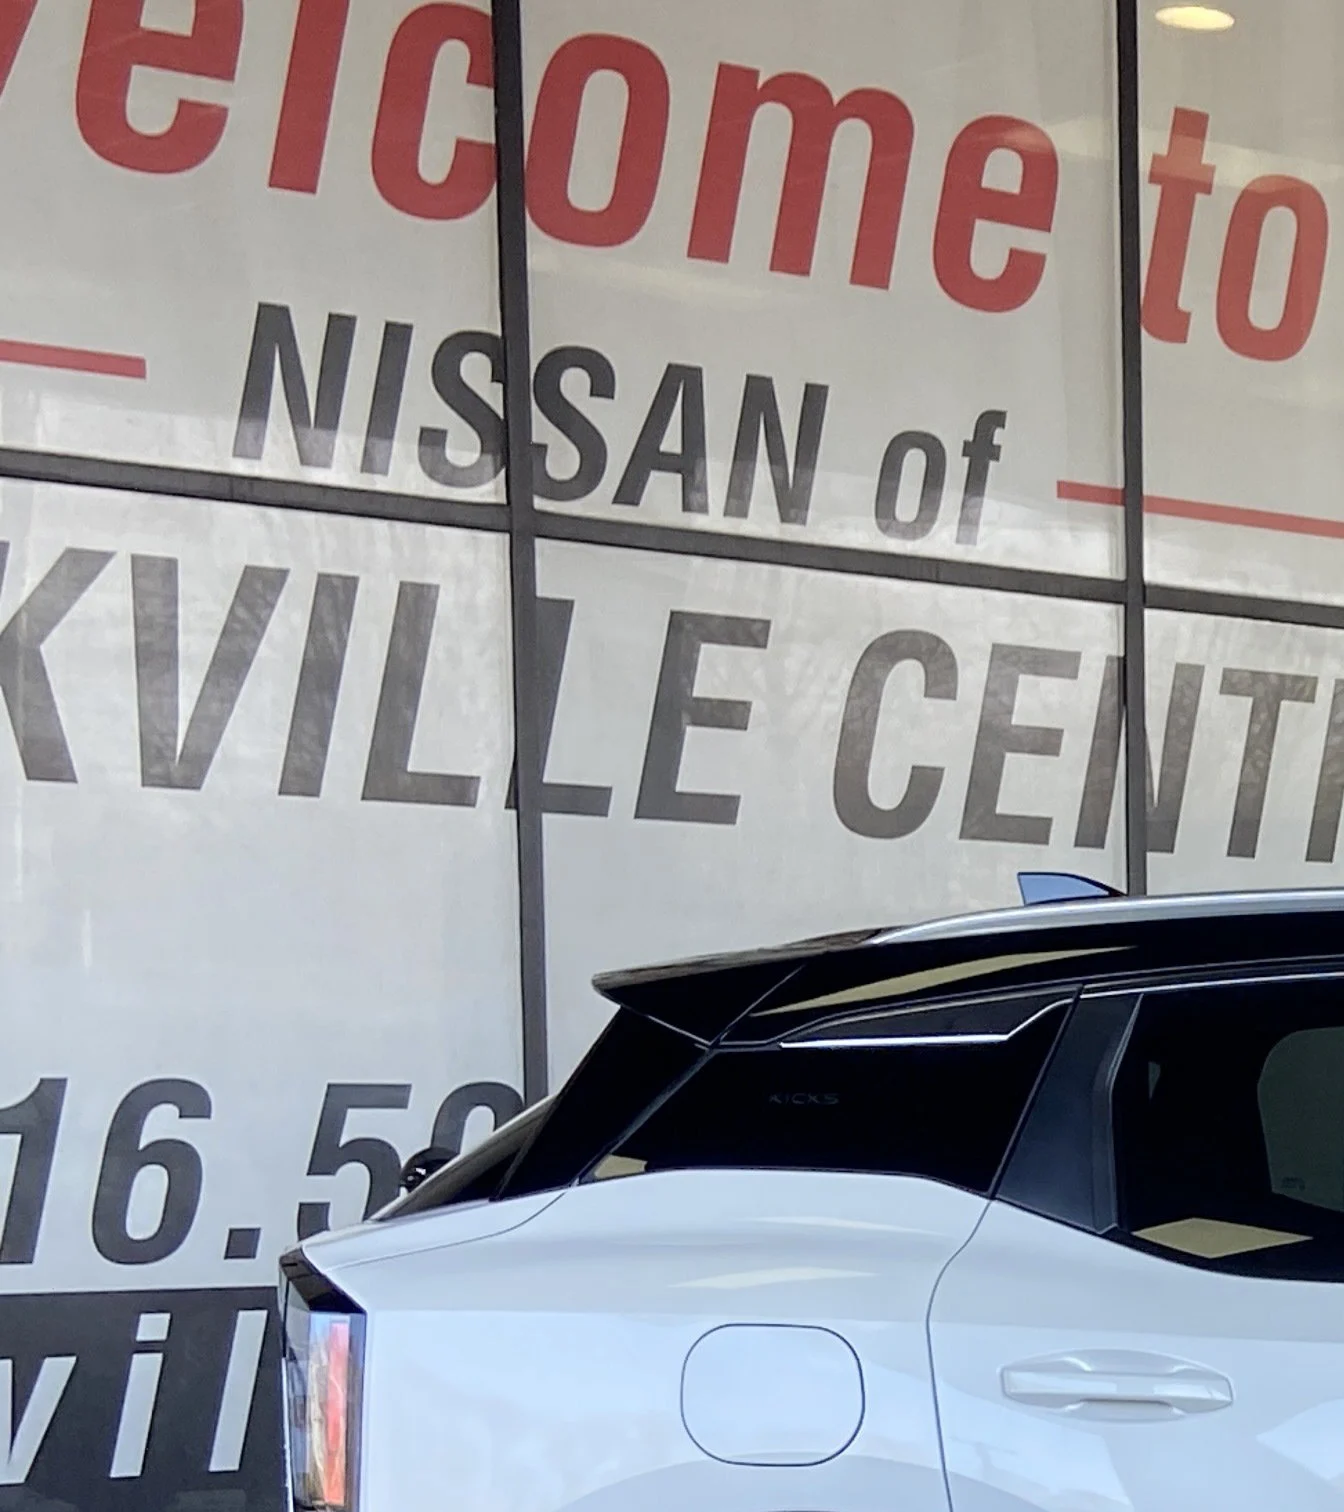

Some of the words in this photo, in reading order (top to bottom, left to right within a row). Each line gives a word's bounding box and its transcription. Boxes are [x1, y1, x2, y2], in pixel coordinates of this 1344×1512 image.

[1141, 106, 1330, 362] to
[231, 302, 830, 527] NISSAN
[874, 410, 1007, 546] of
[768, 1092, 839, 1105] KICKS
